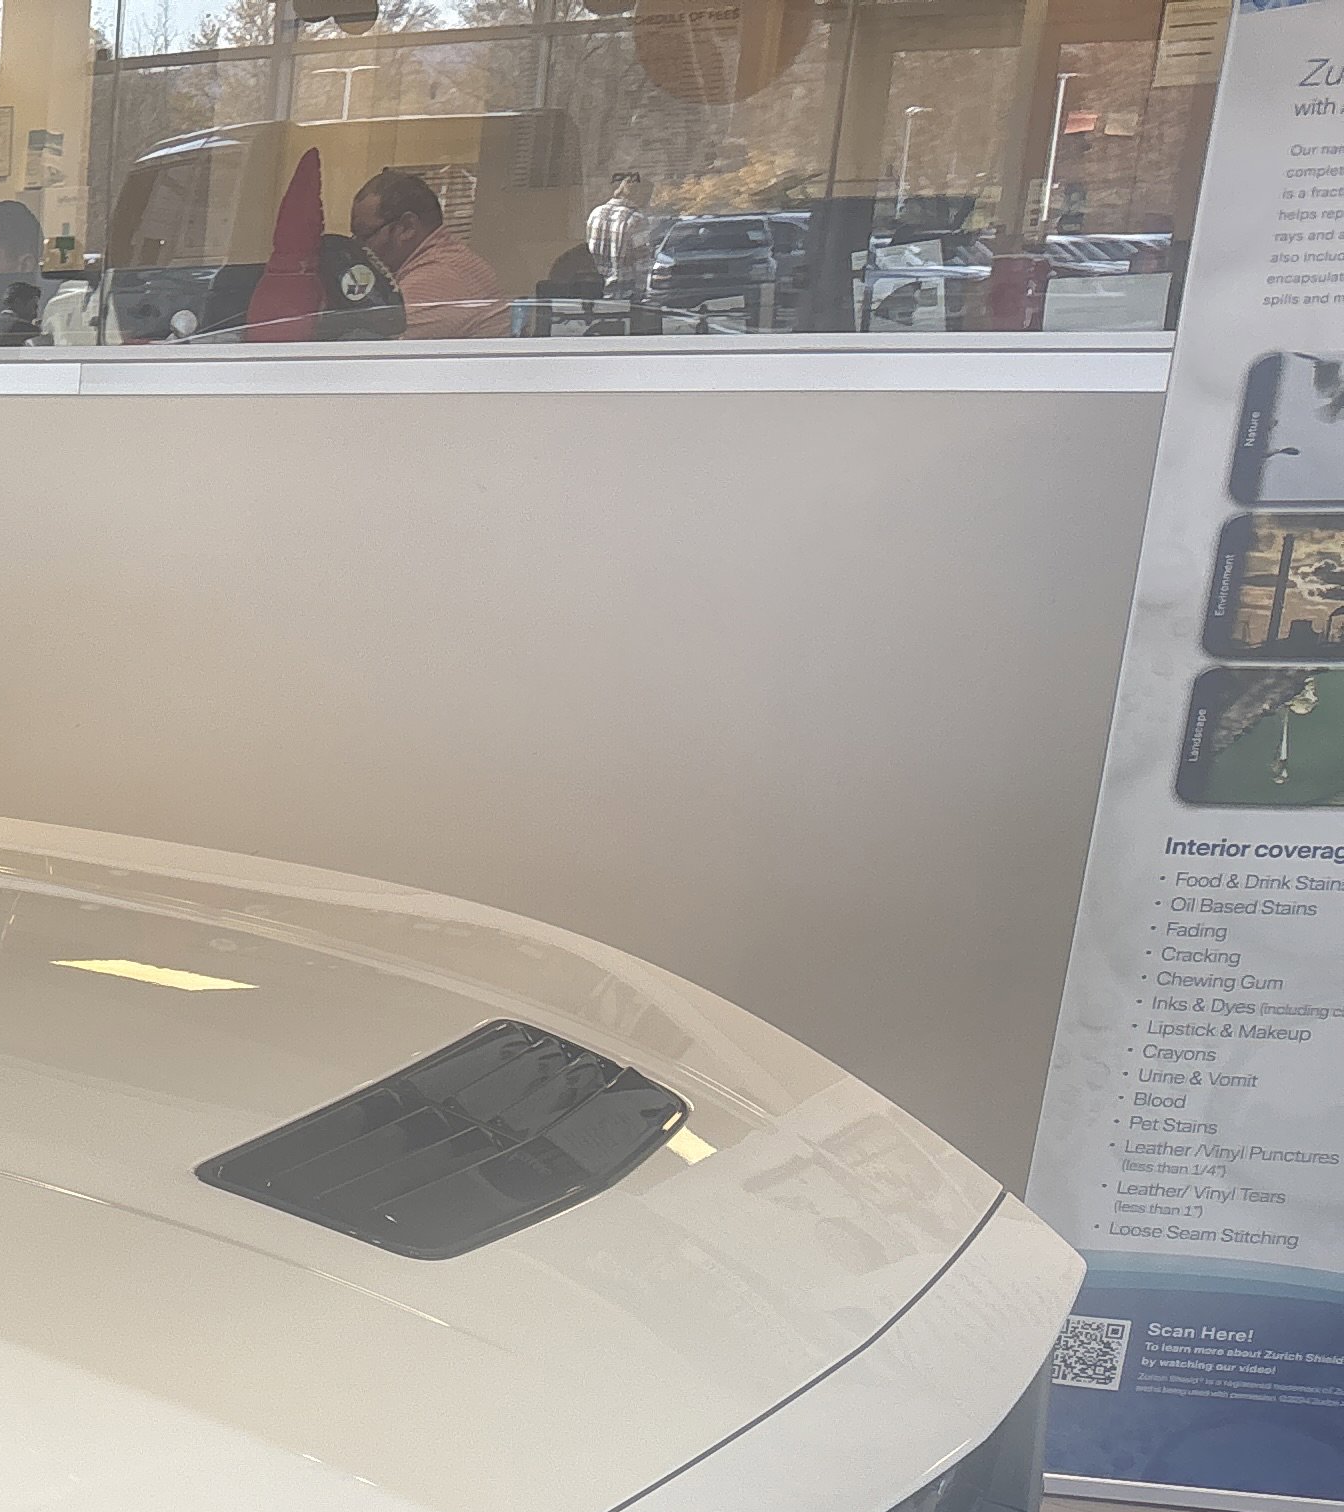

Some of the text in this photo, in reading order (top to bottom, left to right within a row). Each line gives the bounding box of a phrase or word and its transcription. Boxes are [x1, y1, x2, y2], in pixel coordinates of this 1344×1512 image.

[1295, 98, 1336, 117] with
[1291, 144, 1317, 157] Our
[1282, 189, 1293, 200] is
[1297, 189, 1306, 199] a
[1278, 209, 1317, 222] helps
[1274, 231, 1304, 244] rays
[1308, 230, 1334, 241] and
[1270, 252, 1300, 264] also
[1263, 293, 1300, 307] spills
[1303, 293, 1329, 304] and
[1243, 411, 1261, 447] Nature
[1214, 554, 1236, 617] Environment
[1187, 708, 1207, 762] Landscape
[1164, 836, 1252, 858] Interior
[1175, 871, 1223, 888] Food
[1226, 873, 1239, 889] &
[1245, 873, 1291, 890] Drink
[1170, 896, 1318, 916] Oil Based Stains
[1166, 921, 1228, 942] Fading
[1161, 946, 1242, 968] Cracking
[1156, 970, 1284, 993] Chewing Gum
[1151, 996, 1188, 1012] Inks
[1192, 997, 1206, 1012] &
[1211, 998, 1256, 1017] Dyes
[1260, 1002, 1330, 1020] (including
[1147, 1019, 1312, 1043] Lipstick & Makeup
[1142, 1043, 1217, 1063] Crayons
[1138, 1067, 1259, 1088] Urine & Vomit
[1133, 1091, 1187, 1109] Blood
[1129, 1115, 1218, 1135] Pet Stains
[1124, 1139, 1192, 1157] Leather
[1249, 1145, 1340, 1166] Punctures
[1121, 1158, 1154, 1172] (less
[1157, 1160, 1188, 1175] than
[1194, 1184, 1236, 1204] Vinyl
[1240, 1187, 1287, 1204] Tears
[1114, 1200, 1146, 1214] (less
[1149, 1202, 1181, 1217] than
[1109, 1221, 1300, 1250] Loose Seam Stitching
[1148, 1322, 1254, 1343] Scan Here!
[1145, 1341, 1159, 1352] To
[1161, 1342, 1192, 1354] learn
[1194, 1346, 1224, 1356] more
[1227, 1348, 1262, 1359] about
[1264, 1349, 1304, 1361] Zurich
[1141, 1356, 1277, 1375] by watching our video!
